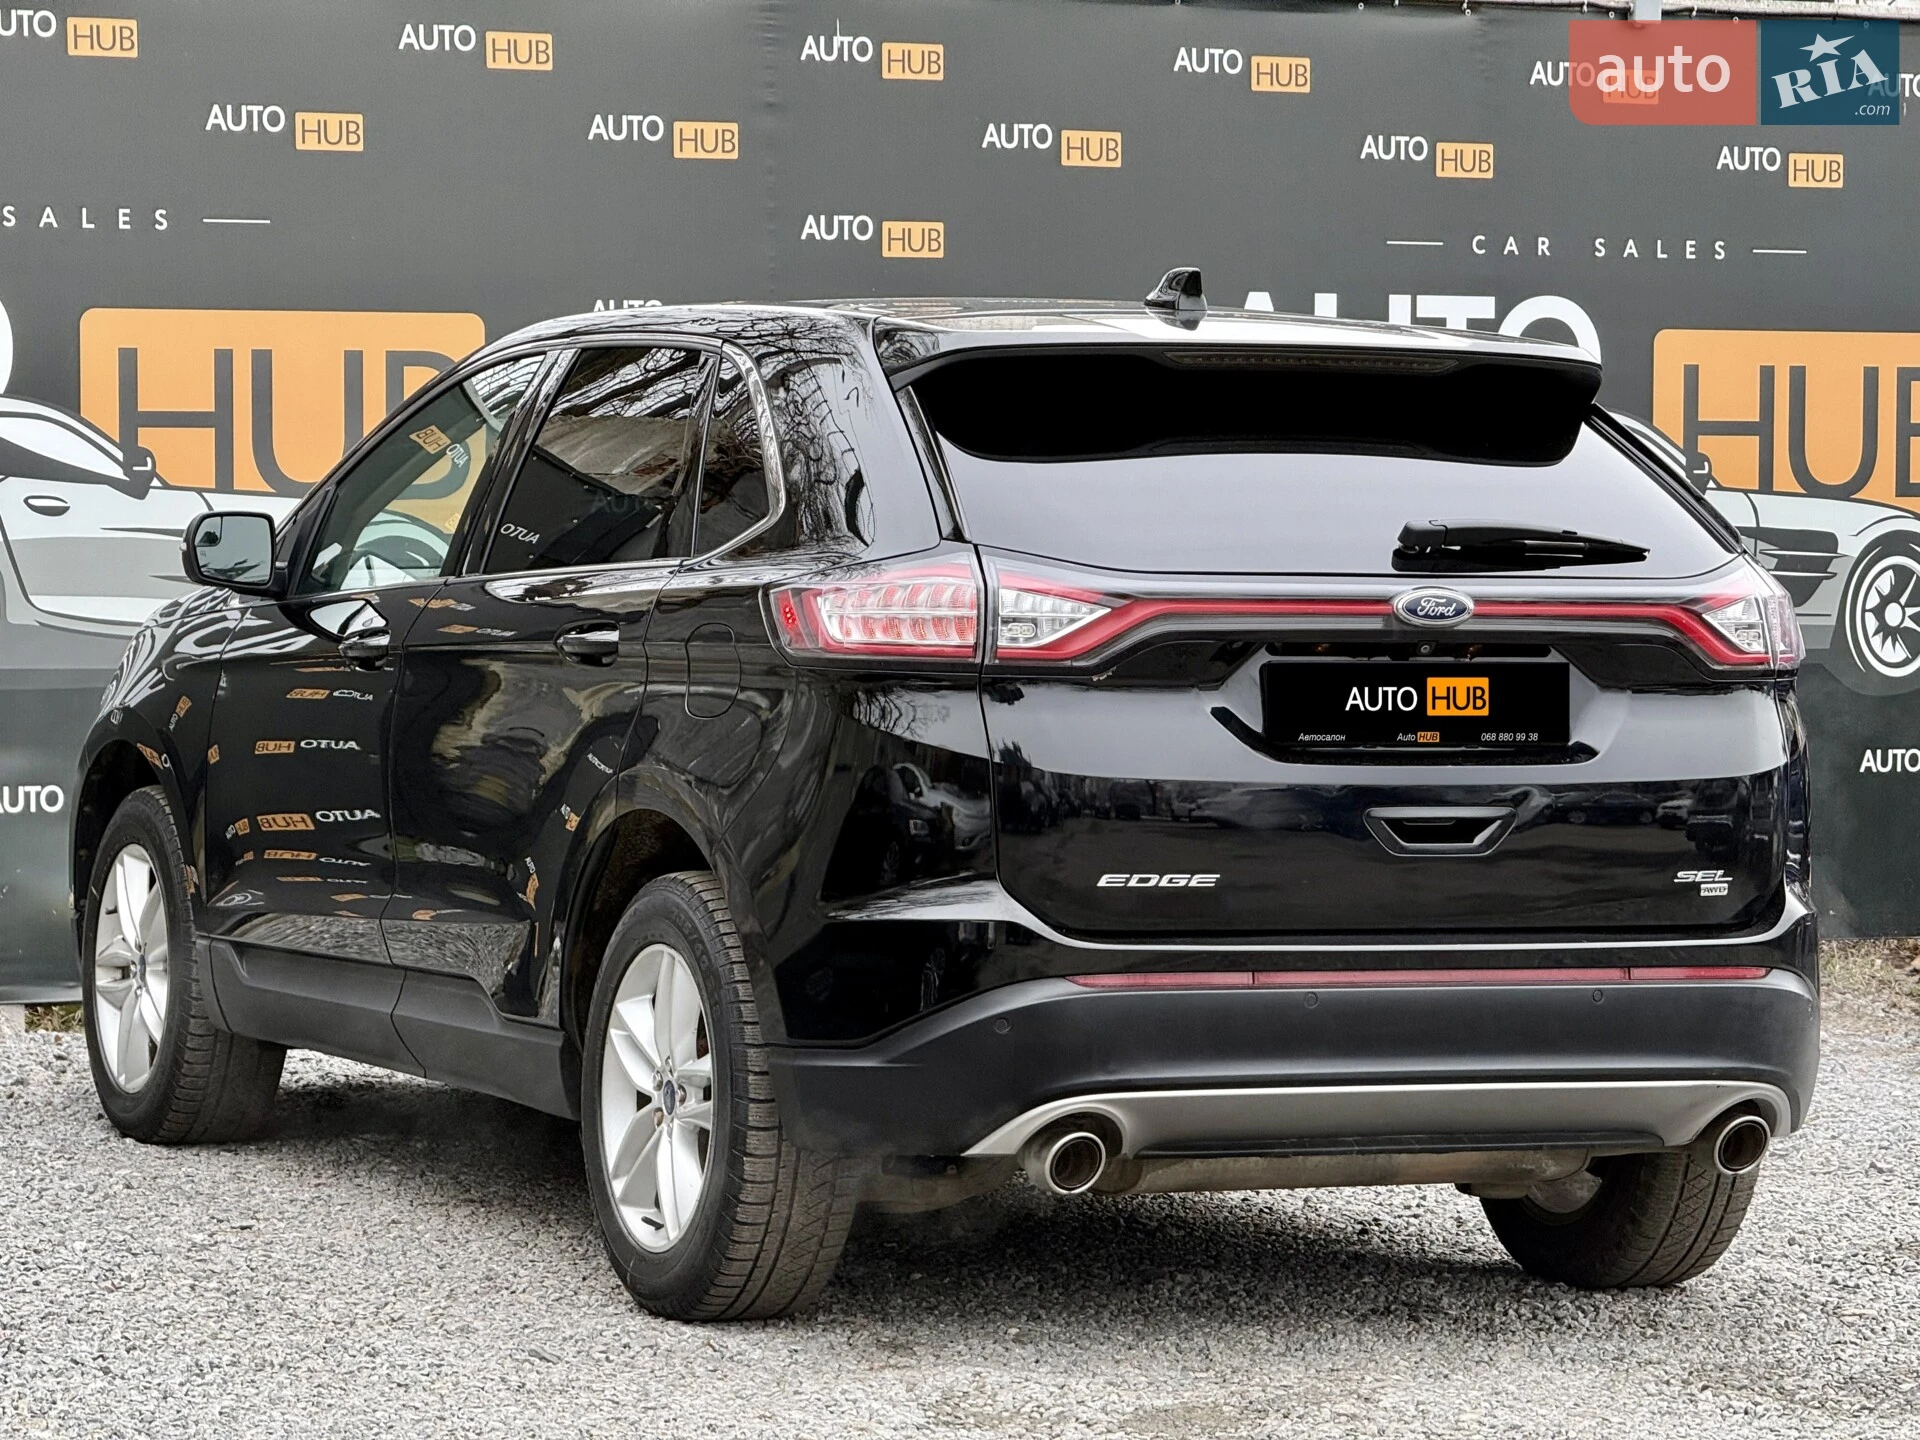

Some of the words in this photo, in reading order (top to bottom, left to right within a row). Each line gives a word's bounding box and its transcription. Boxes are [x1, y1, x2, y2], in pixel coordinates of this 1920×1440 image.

[0, 10, 56, 37] UTO
[73, 23, 136, 52] HUB
[399, 24, 476, 51] AUTO
[491, 37, 551, 65] HUB
[801, 35, 873, 62] AUTO
[887, 49, 942, 75] HUB
[1174, 46, 1242, 74] AUTO
[1256, 62, 1308, 88] HUB
[1529, 61, 1596, 87] AUTO
[206, 104, 286, 132] AUTO
[301, 118, 361, 146] HUB
[588, 114, 664, 141] AUTO
[679, 127, 736, 154] HUB
[982, 123, 1053, 149] AUTO
[1066, 136, 1119, 163] HUB
[1361, 135, 1428, 161] AUTO
[1441, 148, 1491, 174] HUB
[1717, 146, 1781, 171] AUTO
[1793, 159, 1841, 184] HUB
[2, 205, 168, 231] SALES
[801, 214, 874, 241] AUTO
[887, 227, 942, 253] HUB
[1472, 235, 1551, 255] CAR
[1594, 238, 1726, 260] SALES
[1417, 597, 1457, 617] Ford
[1345, 687, 1417, 712] AUTO
[1431, 686, 1487, 711] HUB
[1298, 733, 1346, 742] Автосалон
[1397, 733, 1416, 742] Auto
[1418, 733, 1439, 742] HUB
[1481, 733, 1497, 742] 068
[1498, 733, 1514, 742] 880
[1515, 733, 1526, 742] 99
[1528, 733, 1539, 742] 38
[1860, 748, 1920, 773] AUTO
[0, 784, 65, 813] UTO
[1096, 873, 1221, 887] EDGE
[1673, 870, 1734, 882] SEL
